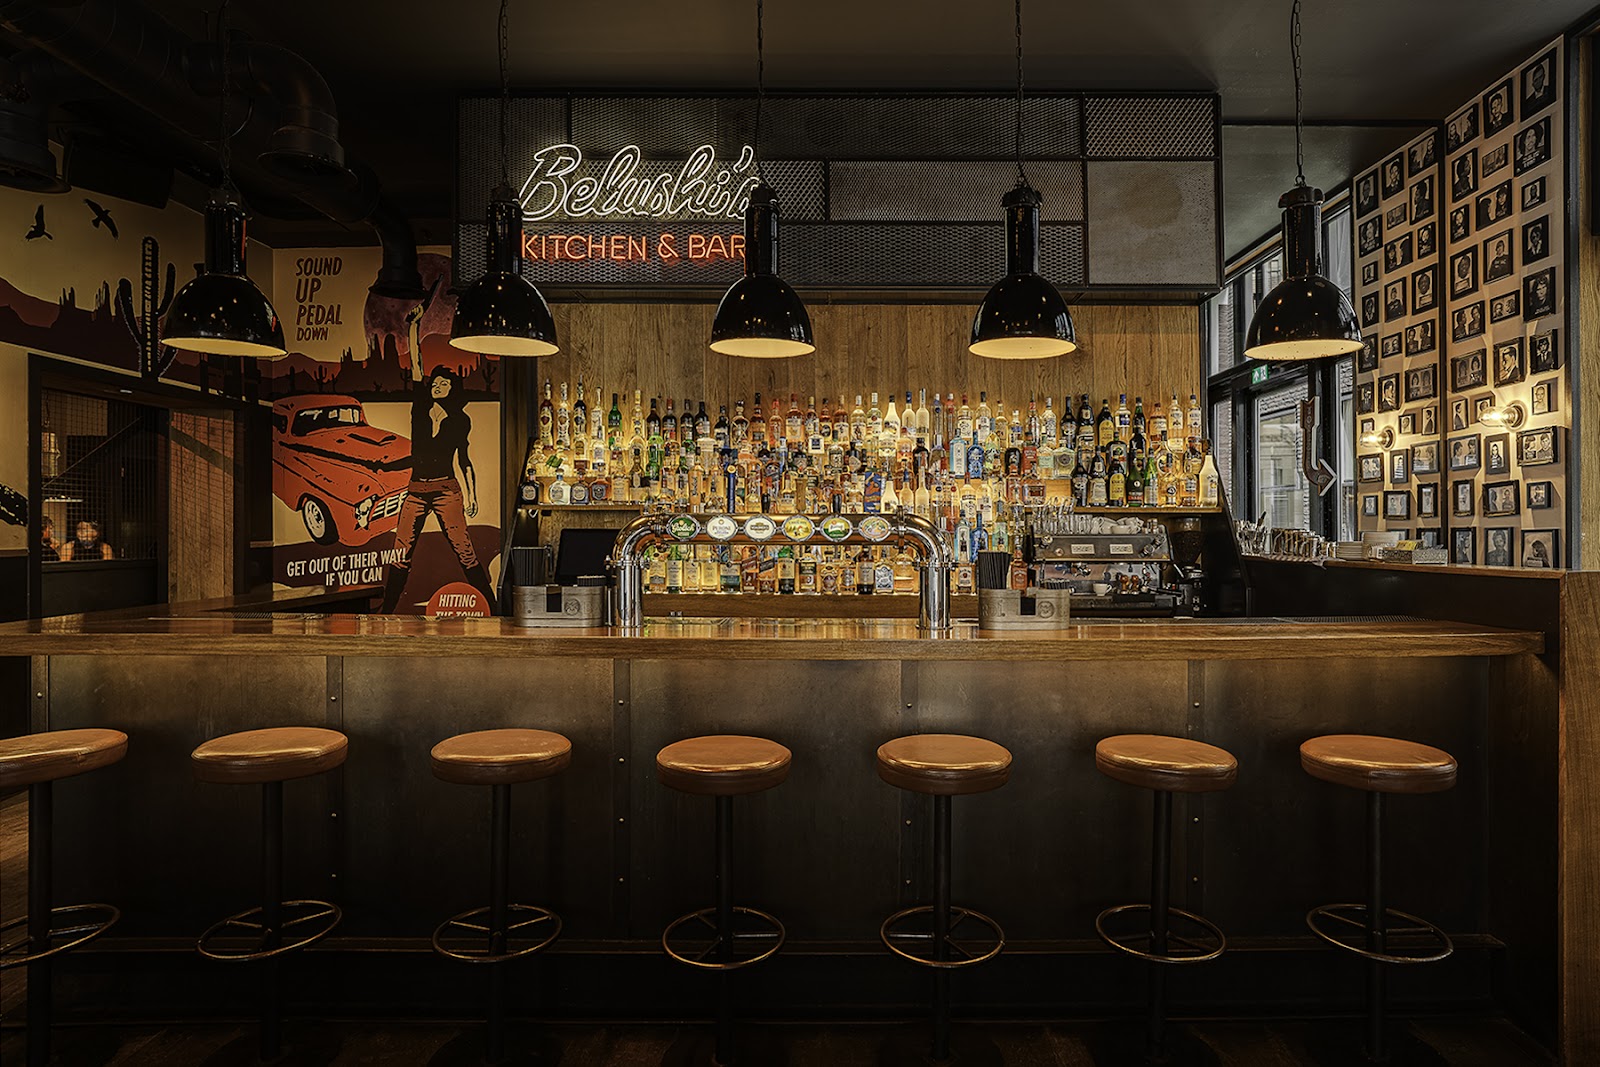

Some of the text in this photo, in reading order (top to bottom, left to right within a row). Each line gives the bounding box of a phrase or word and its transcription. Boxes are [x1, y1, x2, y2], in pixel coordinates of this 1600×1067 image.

[519, 144, 760, 221] Belushi's
[521, 233, 746, 260] KITCHEN & BAR
[295, 257, 342, 276] SOUND
[295, 278, 322, 303] UP
[296, 304, 342, 326] PEDAL
[296, 327, 328, 341] DOWN
[287, 548, 406, 577] GET OUT OF THEIR WAY!
[325, 567, 383, 586] IF YOU CAN
[438, 594, 477, 608] HITTING
